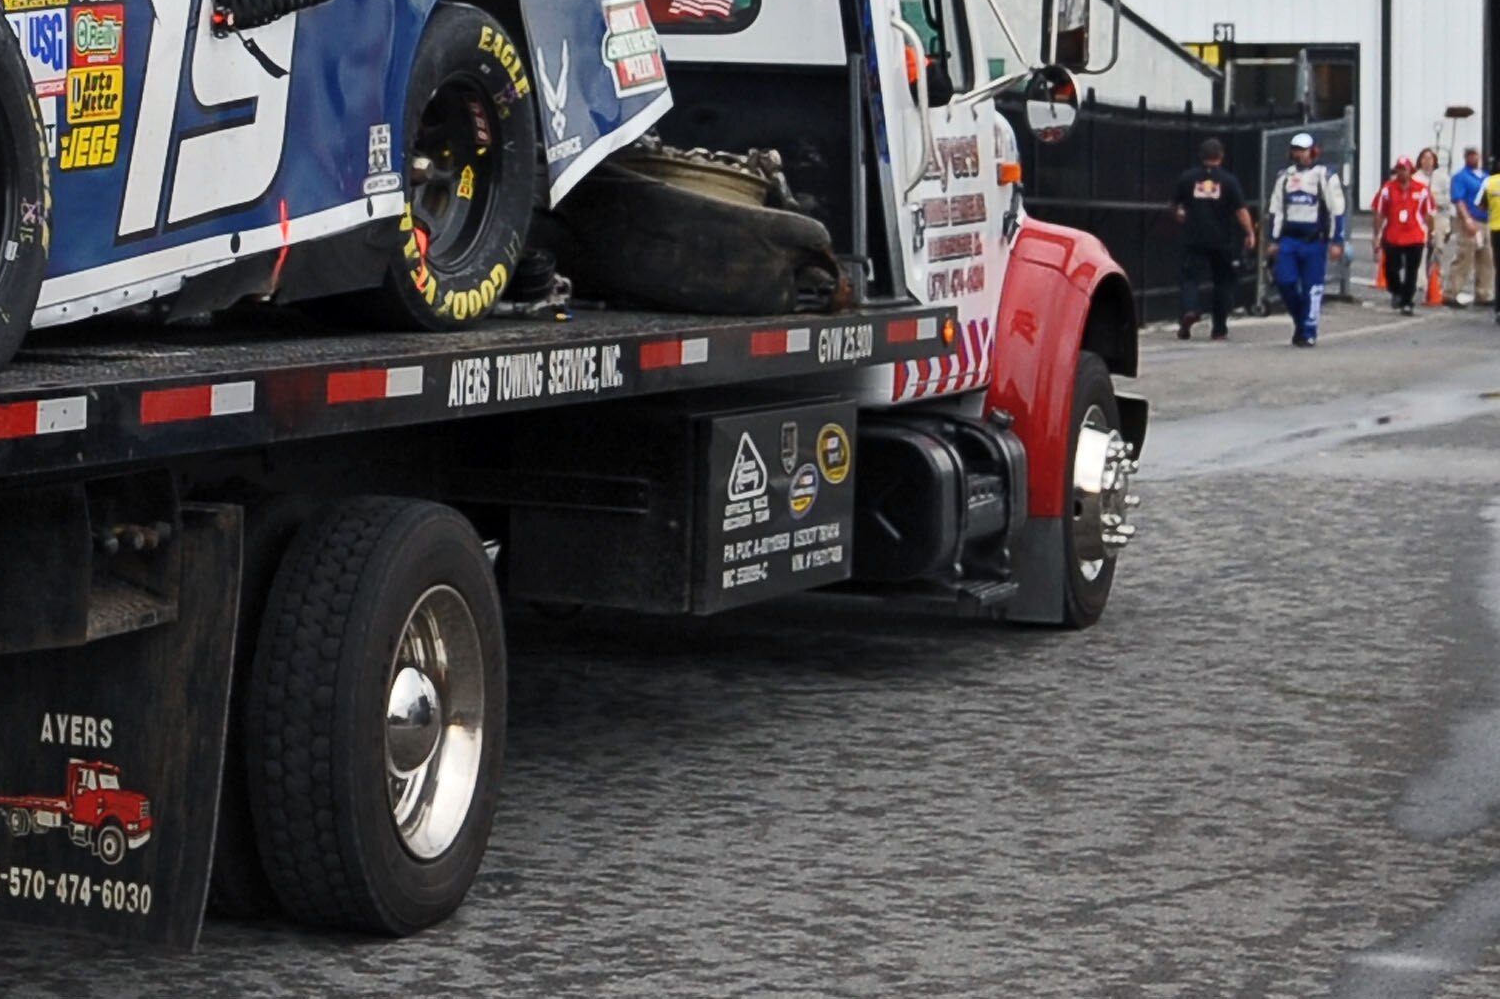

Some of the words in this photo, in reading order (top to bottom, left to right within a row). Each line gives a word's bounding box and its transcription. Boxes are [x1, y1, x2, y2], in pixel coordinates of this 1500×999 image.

[29, 13, 63, 71] USG
[478, 24, 531, 99] EAGLE
[84, 71, 113, 92] Auto
[59, 122, 121, 171] JEGS
[448, 356, 490, 407] AYERS
[496, 351, 543, 401] TOWING
[548, 346, 599, 395] SERVICE,
[40, 712, 114, 749] AYERS
